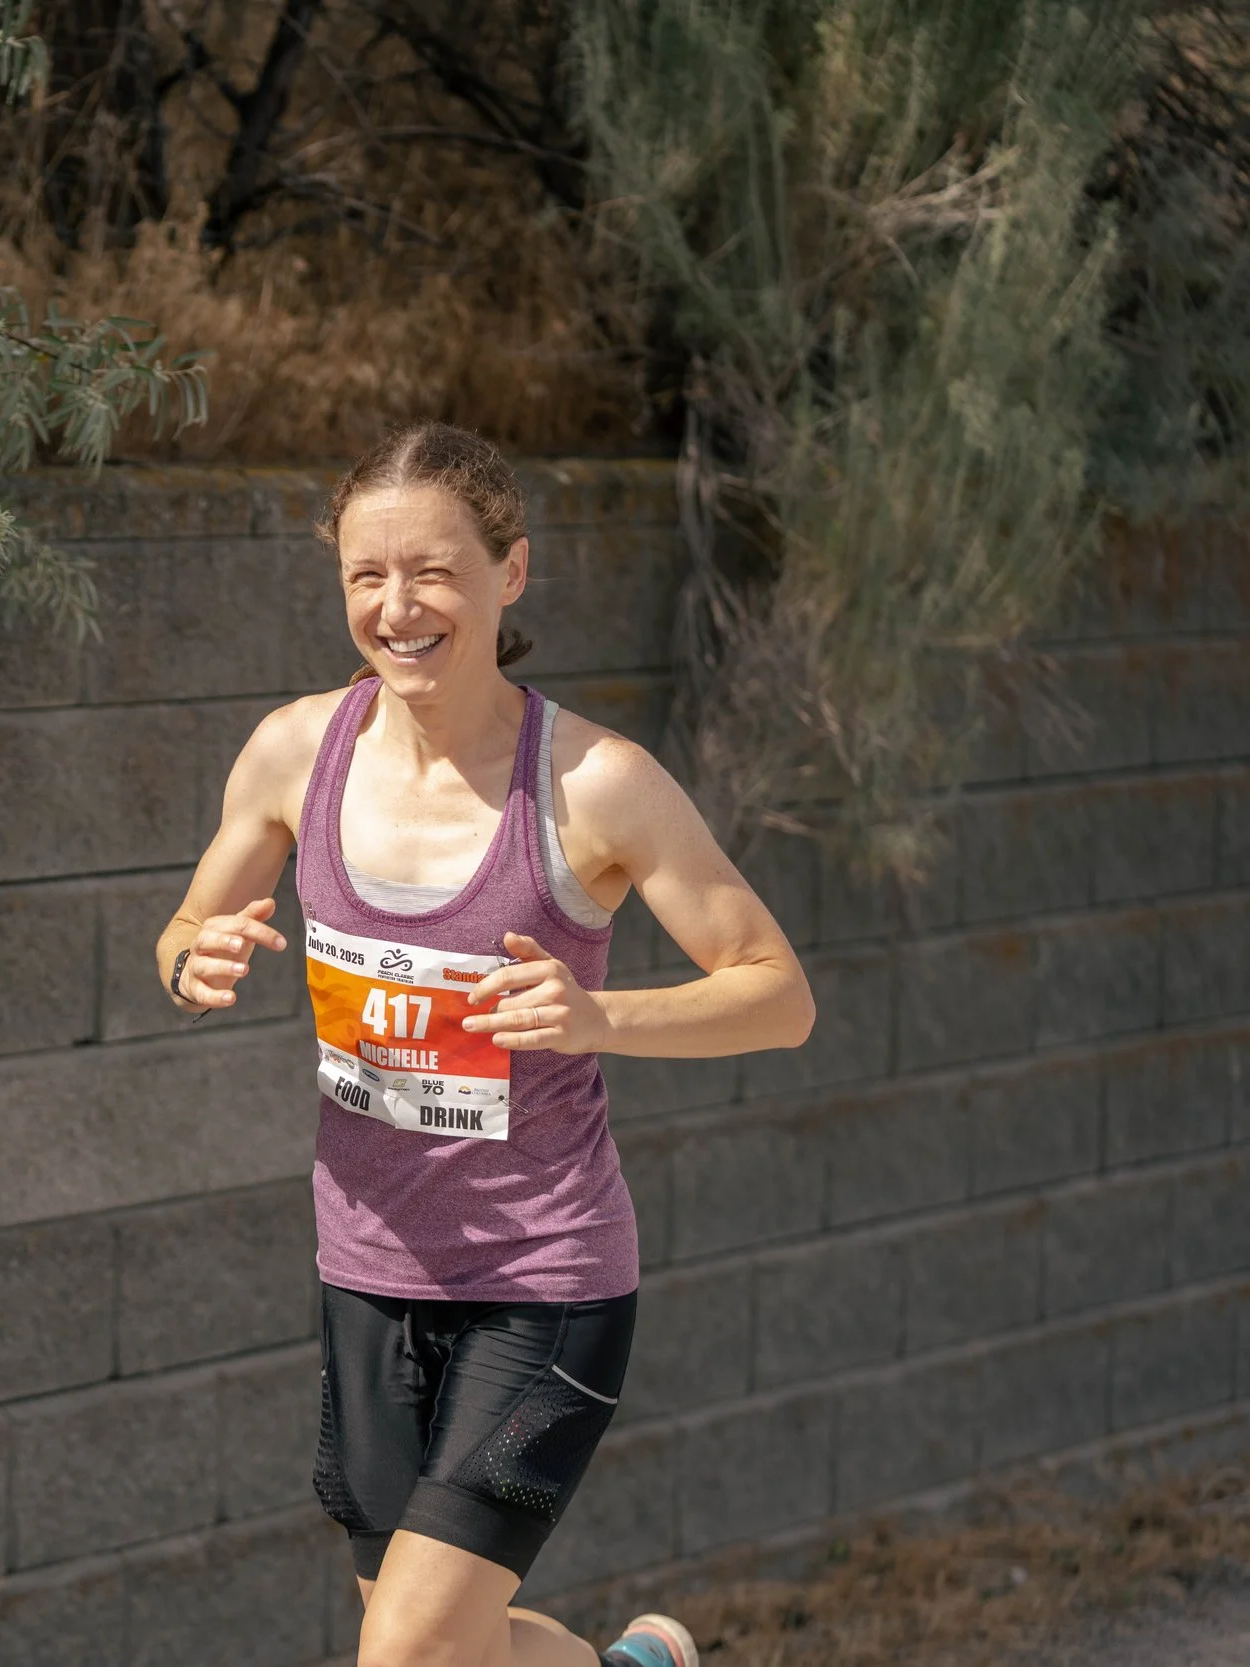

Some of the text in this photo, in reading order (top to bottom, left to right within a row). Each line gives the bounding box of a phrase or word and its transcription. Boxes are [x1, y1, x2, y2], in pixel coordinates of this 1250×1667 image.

[308, 935, 365, 966] July 20, 2025
[442, 967, 490, 984] Standa
[362, 988, 432, 1040] 417
[359, 1039, 439, 1070] MICHELLE
[334, 1075, 371, 1111] FOOD
[421, 1079, 445, 1087] BLUE
[422, 1085, 445, 1096] 70
[419, 1105, 484, 1131] DRINK
